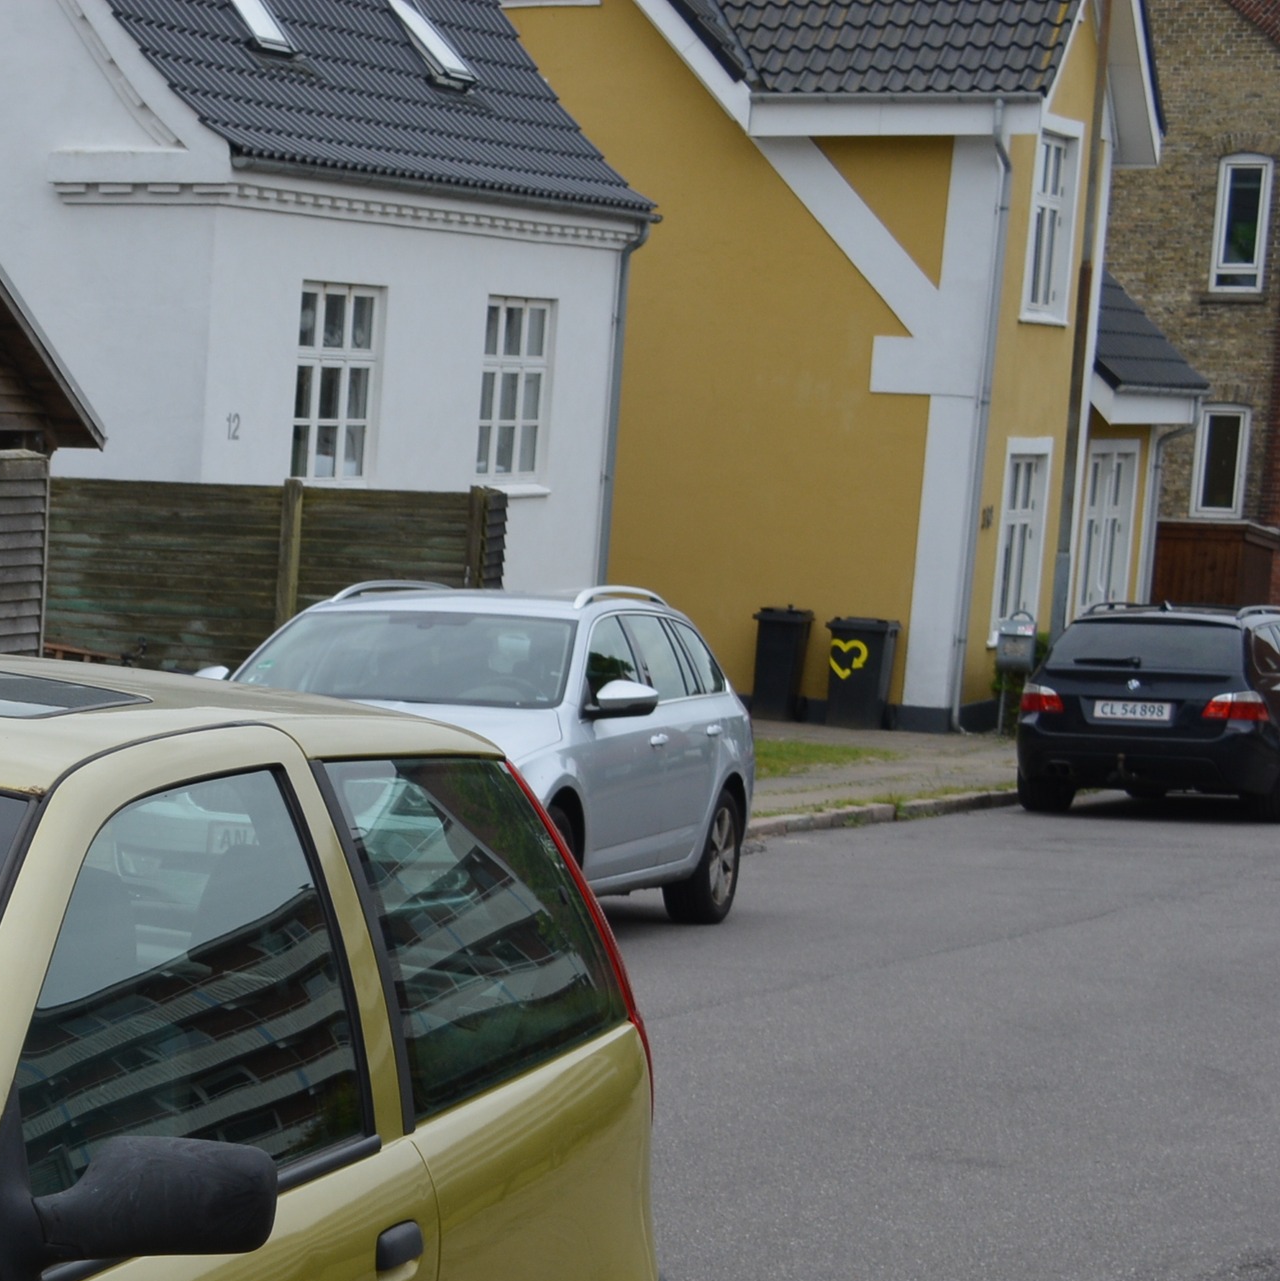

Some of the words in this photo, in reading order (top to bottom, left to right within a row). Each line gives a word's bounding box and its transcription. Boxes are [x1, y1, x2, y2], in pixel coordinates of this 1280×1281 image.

[226, 412, 240, 440] 12
[1101, 702, 1116, 715] CL
[1121, 703, 1137, 716] 54
